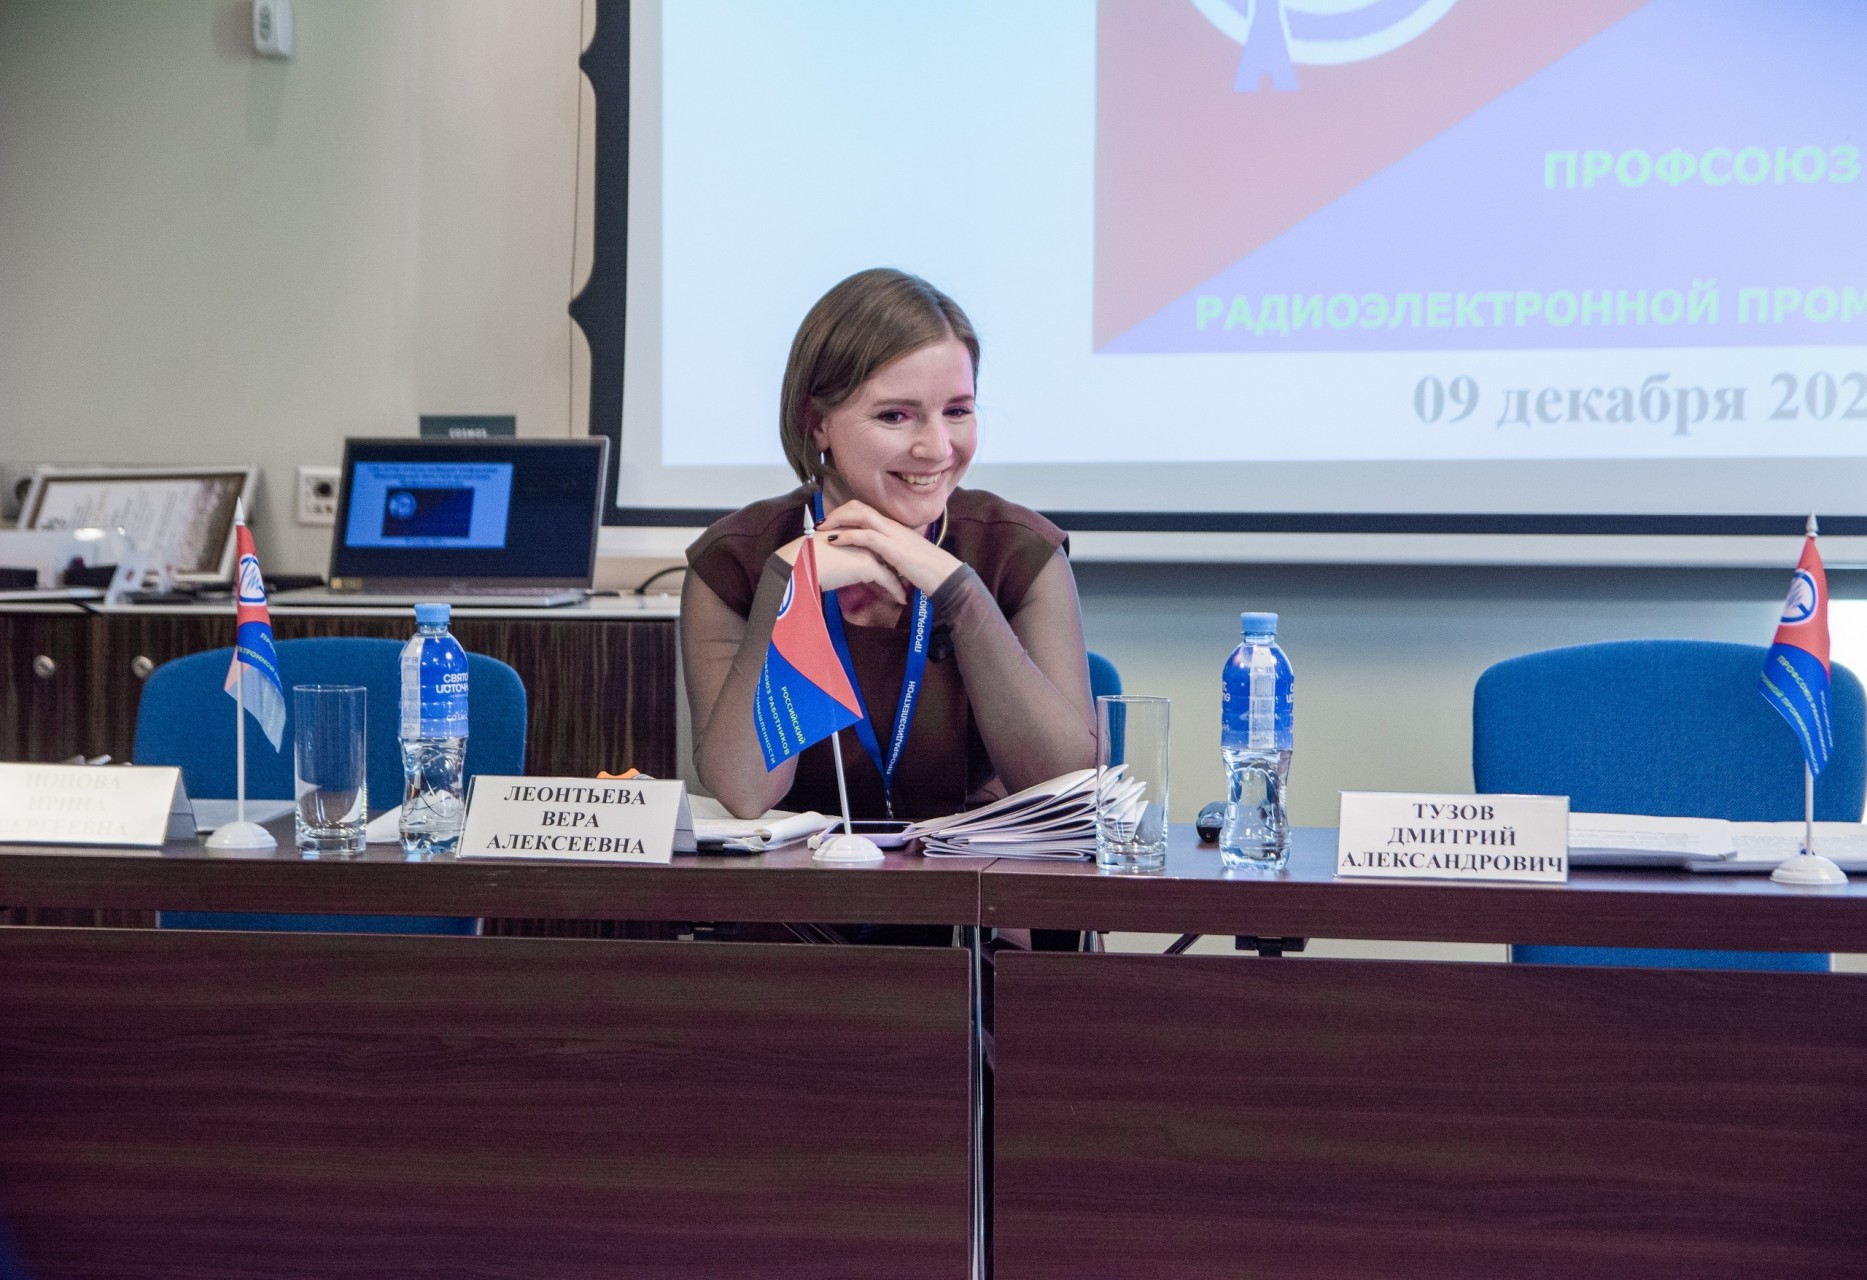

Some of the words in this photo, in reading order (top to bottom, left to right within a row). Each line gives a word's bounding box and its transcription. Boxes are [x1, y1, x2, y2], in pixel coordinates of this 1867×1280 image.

[1544, 145, 1862, 189] ПРОФСОЮЗ
[1195, 279, 1720, 337] РАДИОЭЛЕКТРОННОЙ
[1413, 375, 1480, 424] 09
[1496, 371, 1749, 437] декабря
[768, 695, 790, 756] РАБОТНИКОВ
[781, 686, 806, 745] РОССИЙСКИЙ
[886, 681, 916, 775] ПРОФРАДИОЭЛЕКТРОН
[504, 785, 646, 805] ЛЕОНТЬЕВА
[1413, 803, 1494, 820] ТУЗОВ
[541, 811, 600, 828] ВЕРА
[1387, 826, 1516, 846] ДМИТРИЙ
[486, 834, 645, 854] АЛЕКСЕЕВНА
[1341, 851, 1564, 873] АЛЕКСАНДРОВИЧ
